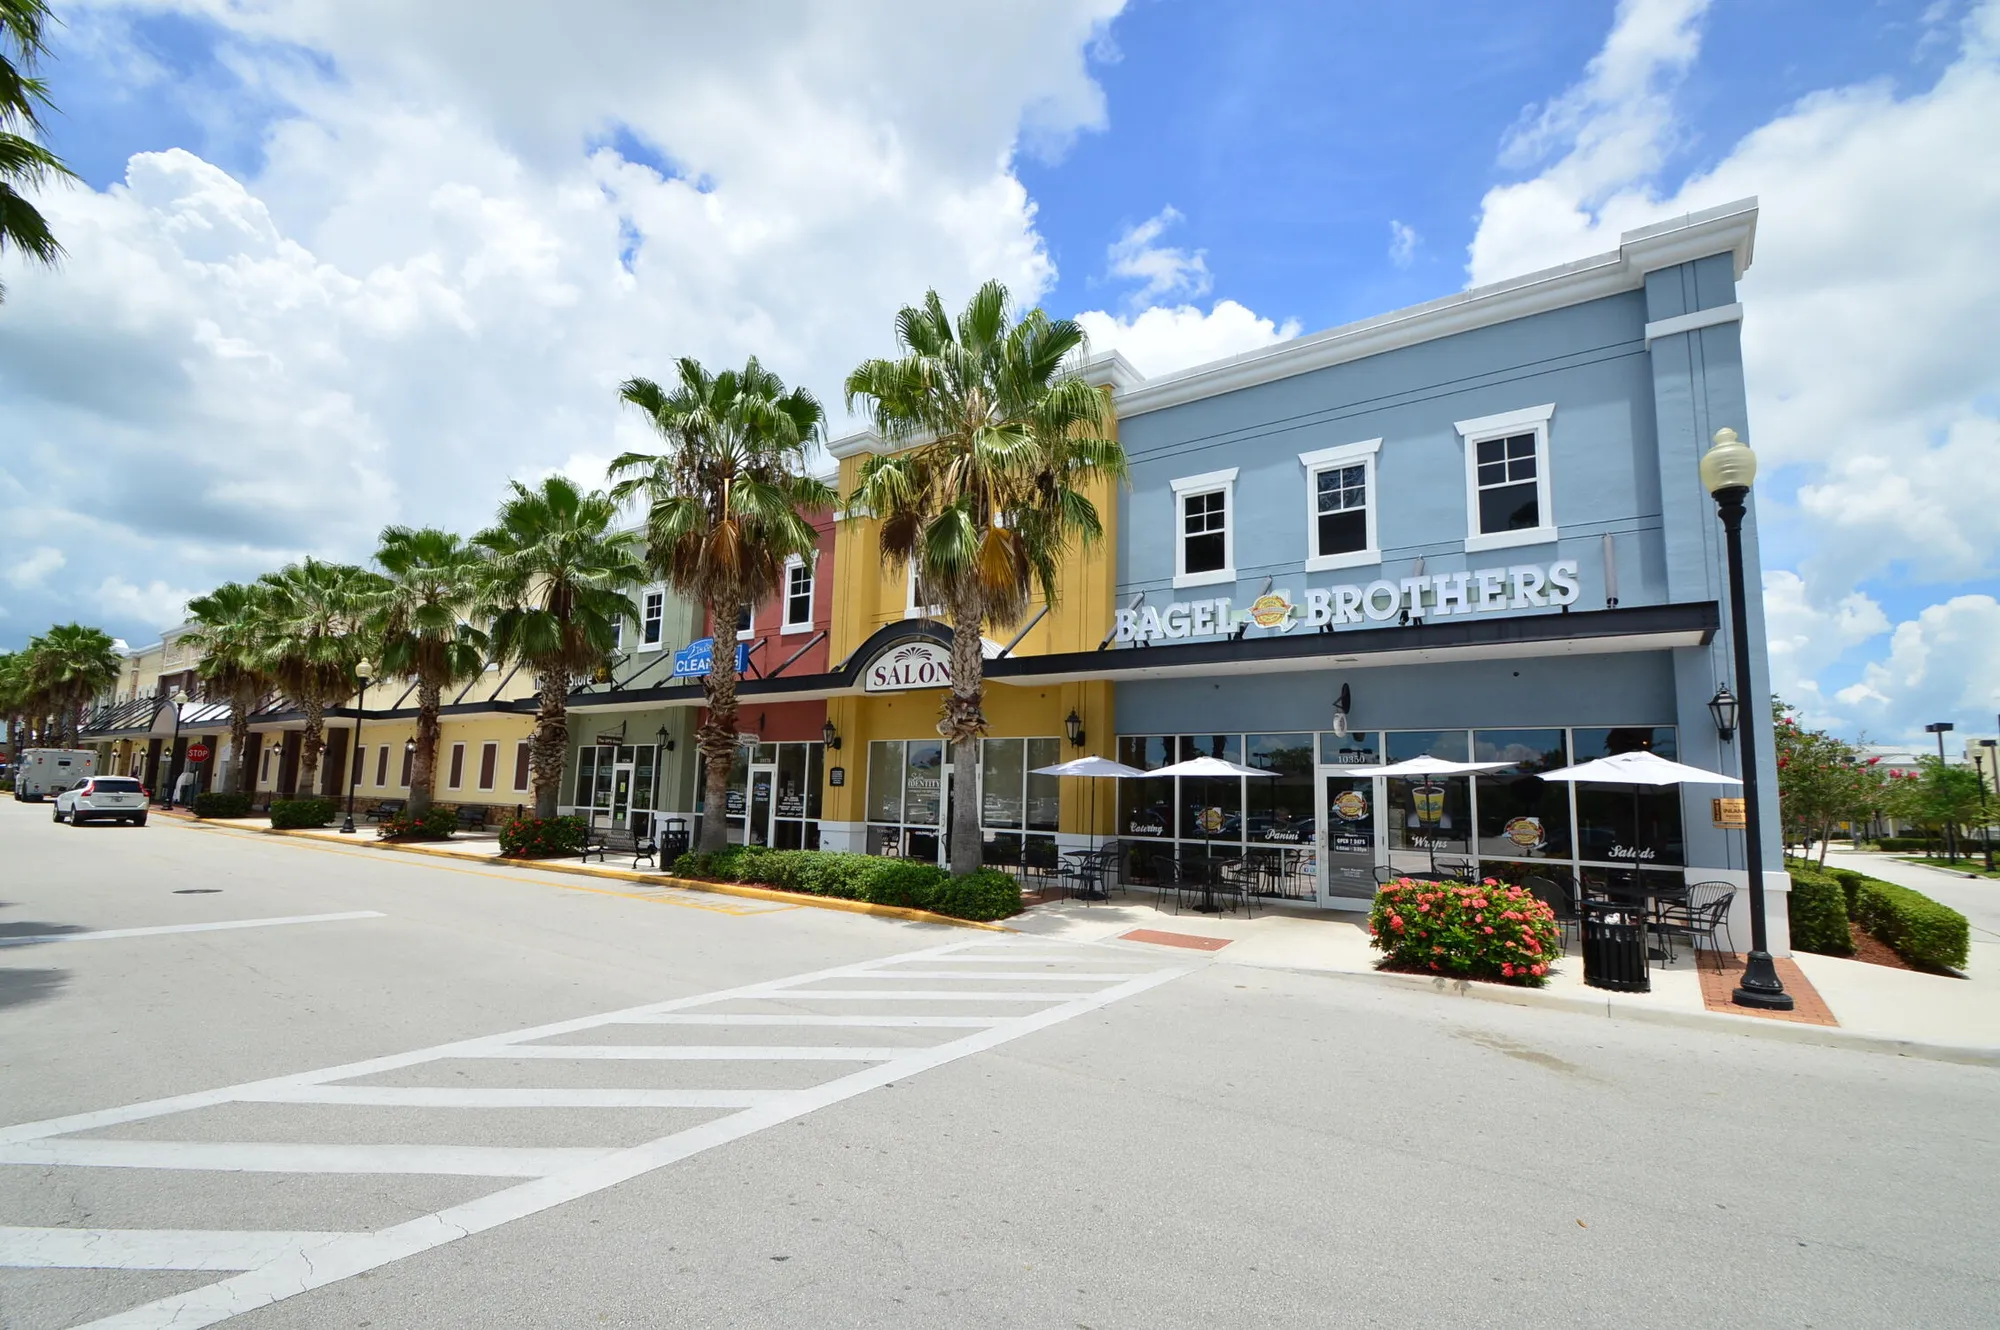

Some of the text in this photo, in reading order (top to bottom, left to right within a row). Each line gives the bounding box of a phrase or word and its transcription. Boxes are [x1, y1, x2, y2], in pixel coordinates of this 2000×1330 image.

[1115, 560, 1580, 642] BAGEL BROTHERS
[676, 656, 740, 673] CLEANS
[873, 661, 952, 687] SALON
[188, 749, 208, 757] STOP
[1338, 755, 1366, 764] 10350
[1130, 821, 1164, 836] Catering
[1265, 828, 1300, 841] Panini
[1608, 845, 1655, 859] Salads
